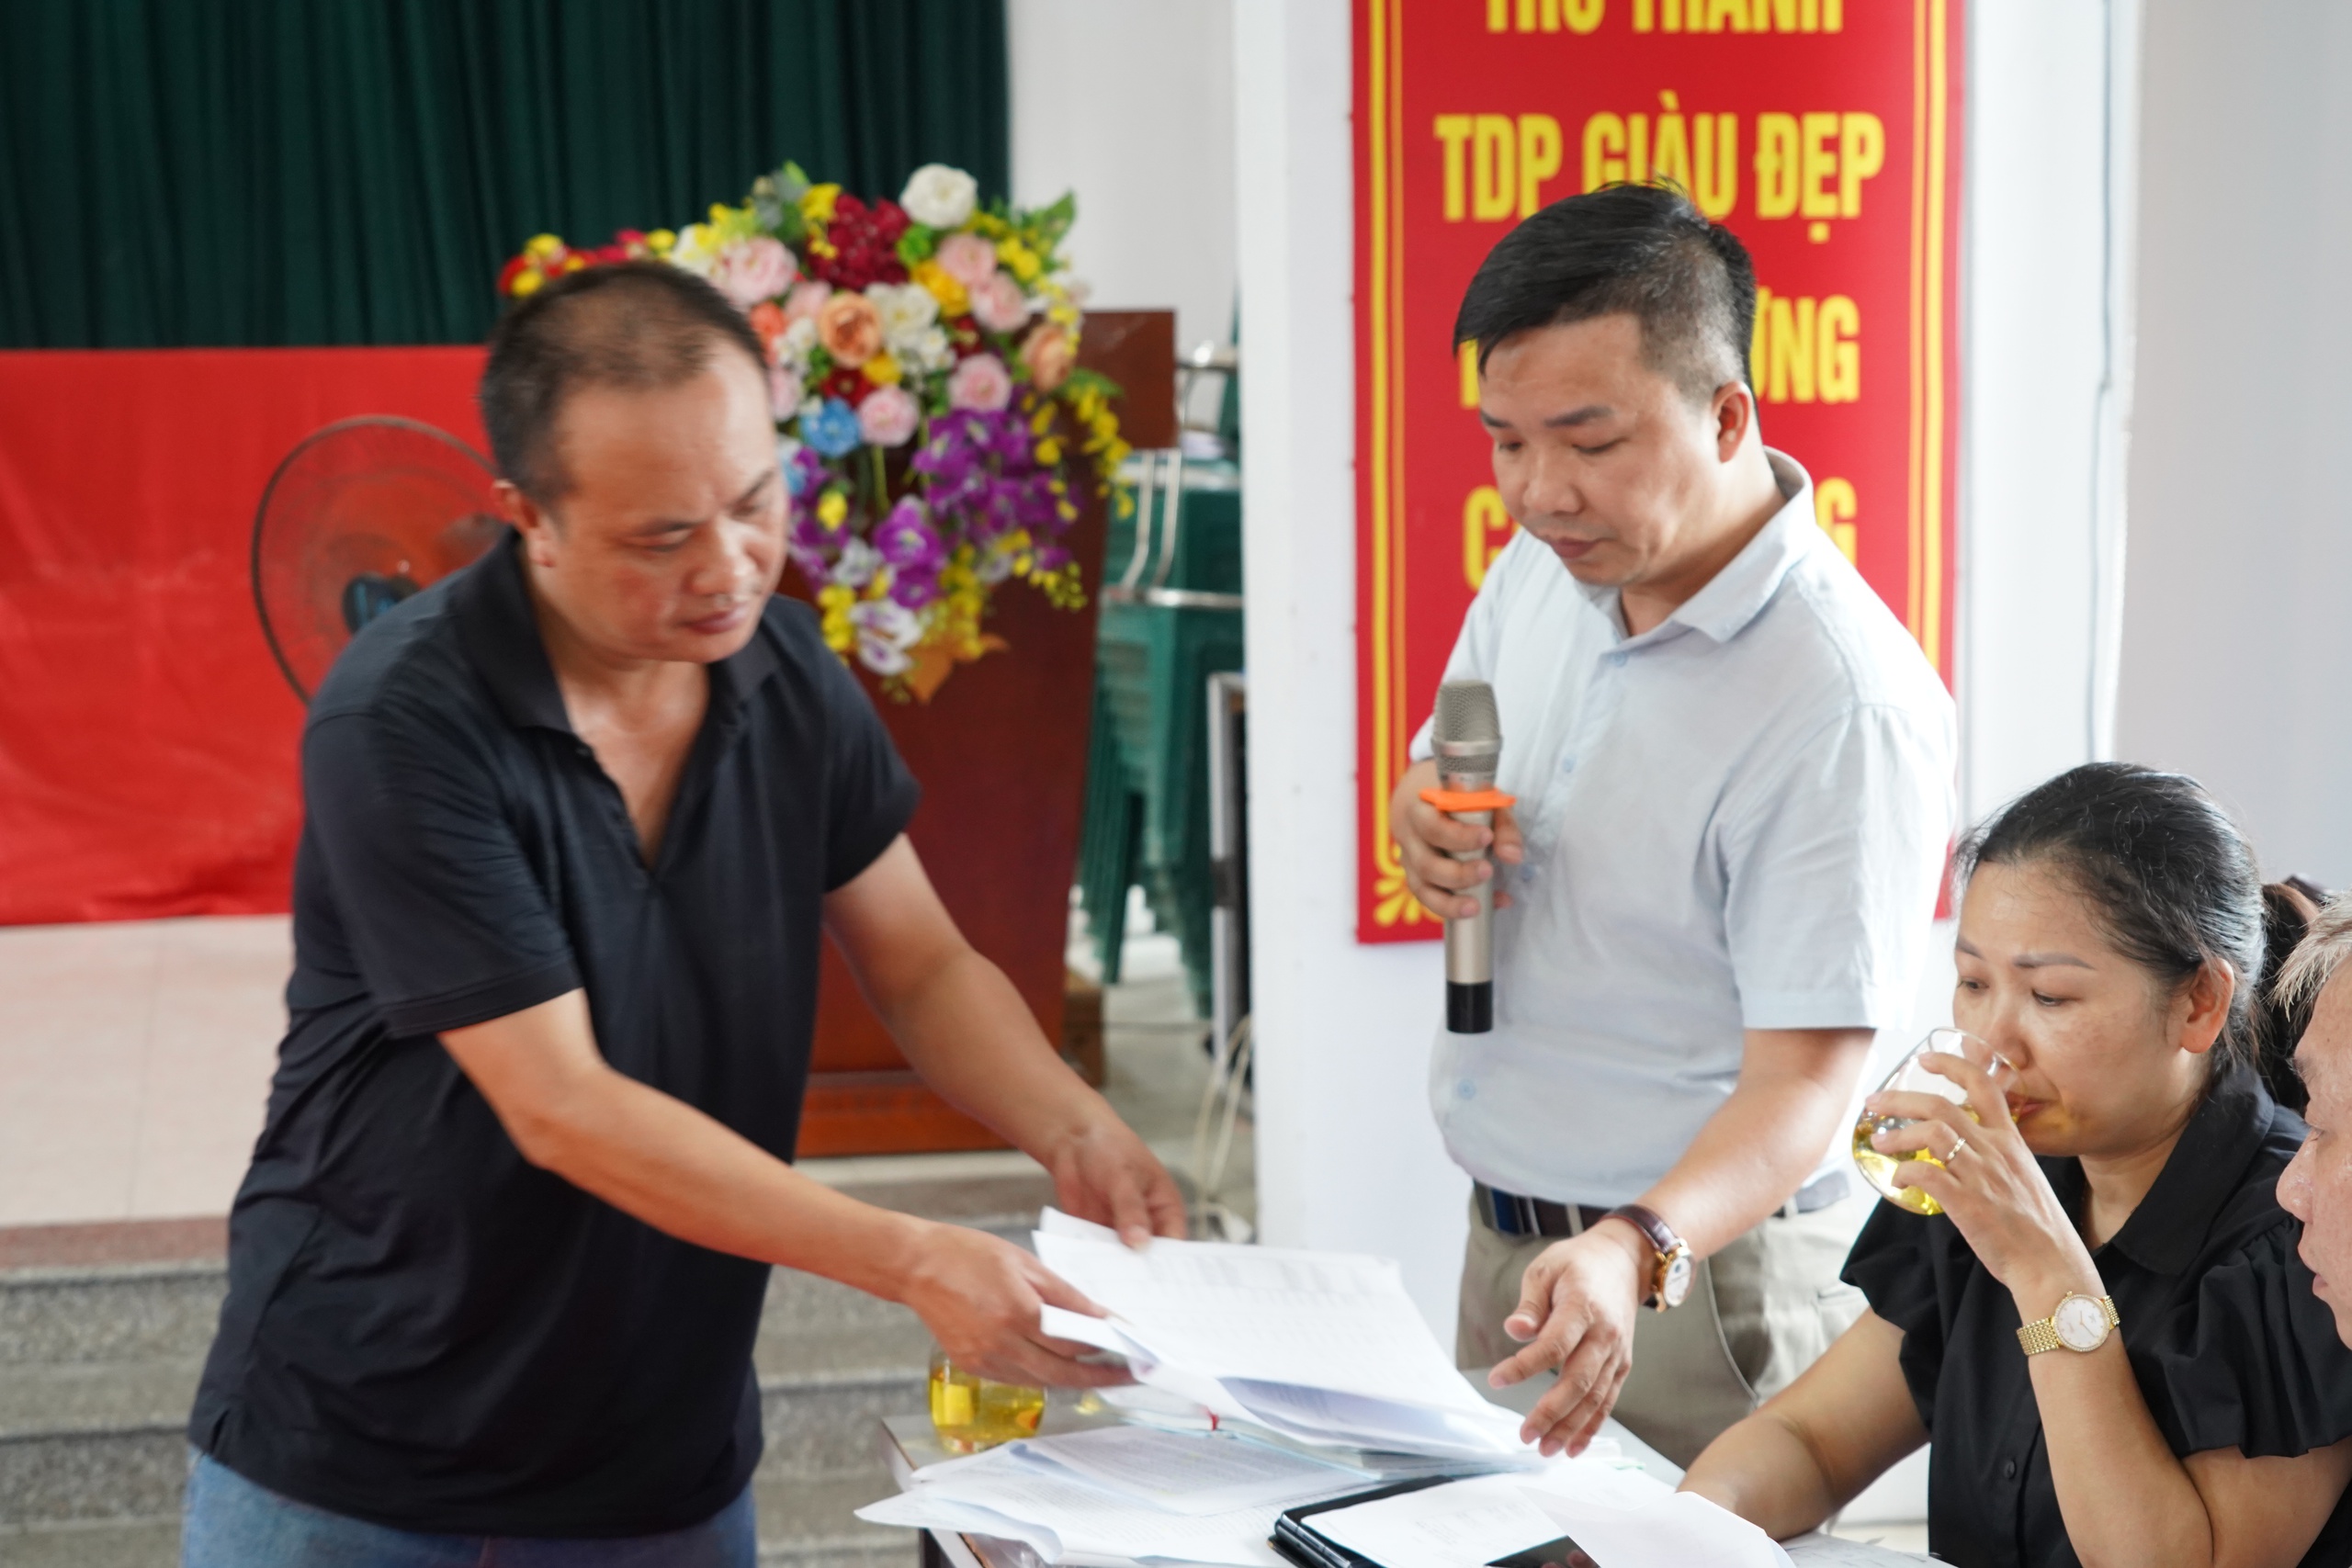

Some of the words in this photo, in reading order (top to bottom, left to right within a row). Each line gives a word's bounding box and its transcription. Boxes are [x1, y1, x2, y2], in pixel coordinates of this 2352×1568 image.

[1433, 112, 1563, 222] TDP
[1582, 88, 1738, 222] GIÀU
[1753, 111, 1885, 244] ĐẸP
